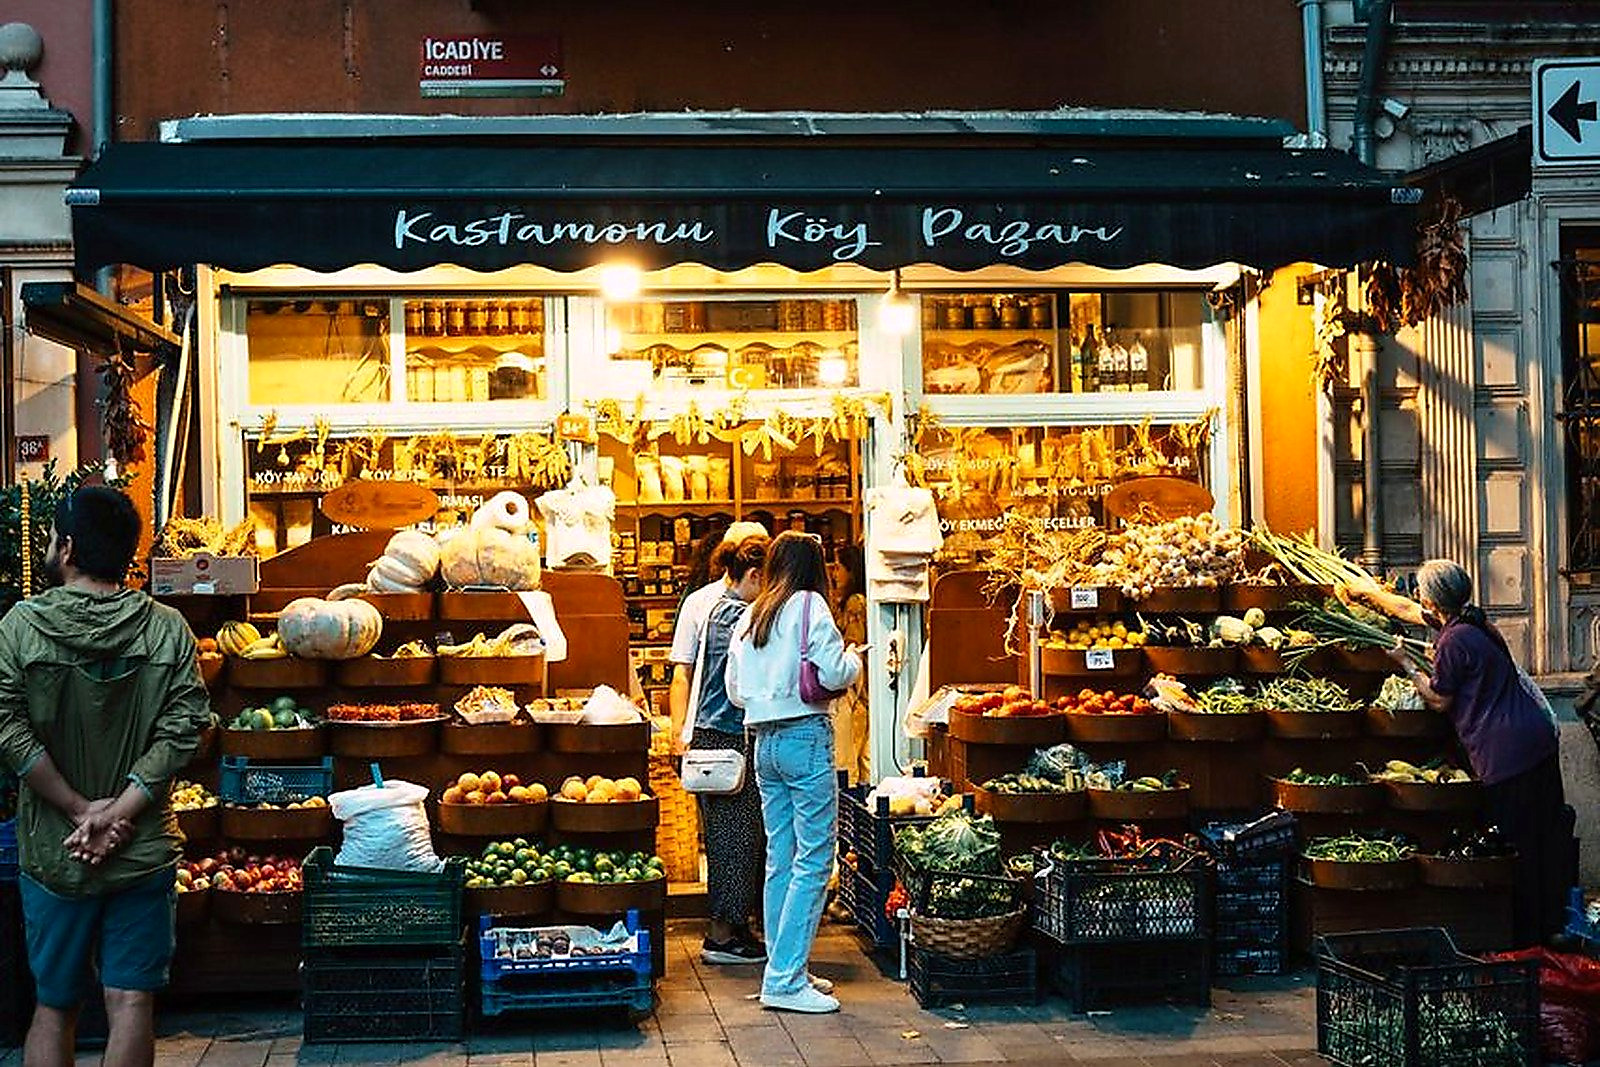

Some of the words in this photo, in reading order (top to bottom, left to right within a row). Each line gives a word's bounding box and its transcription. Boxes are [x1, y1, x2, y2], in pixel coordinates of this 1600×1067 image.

[425, 38, 504, 60] İCADİYE
[424, 64, 472, 76] CADDESİ
[394, 210, 714, 249] Kastamonu
[766, 208, 882, 261] Köy
[255, 469, 283, 484] KÖY
